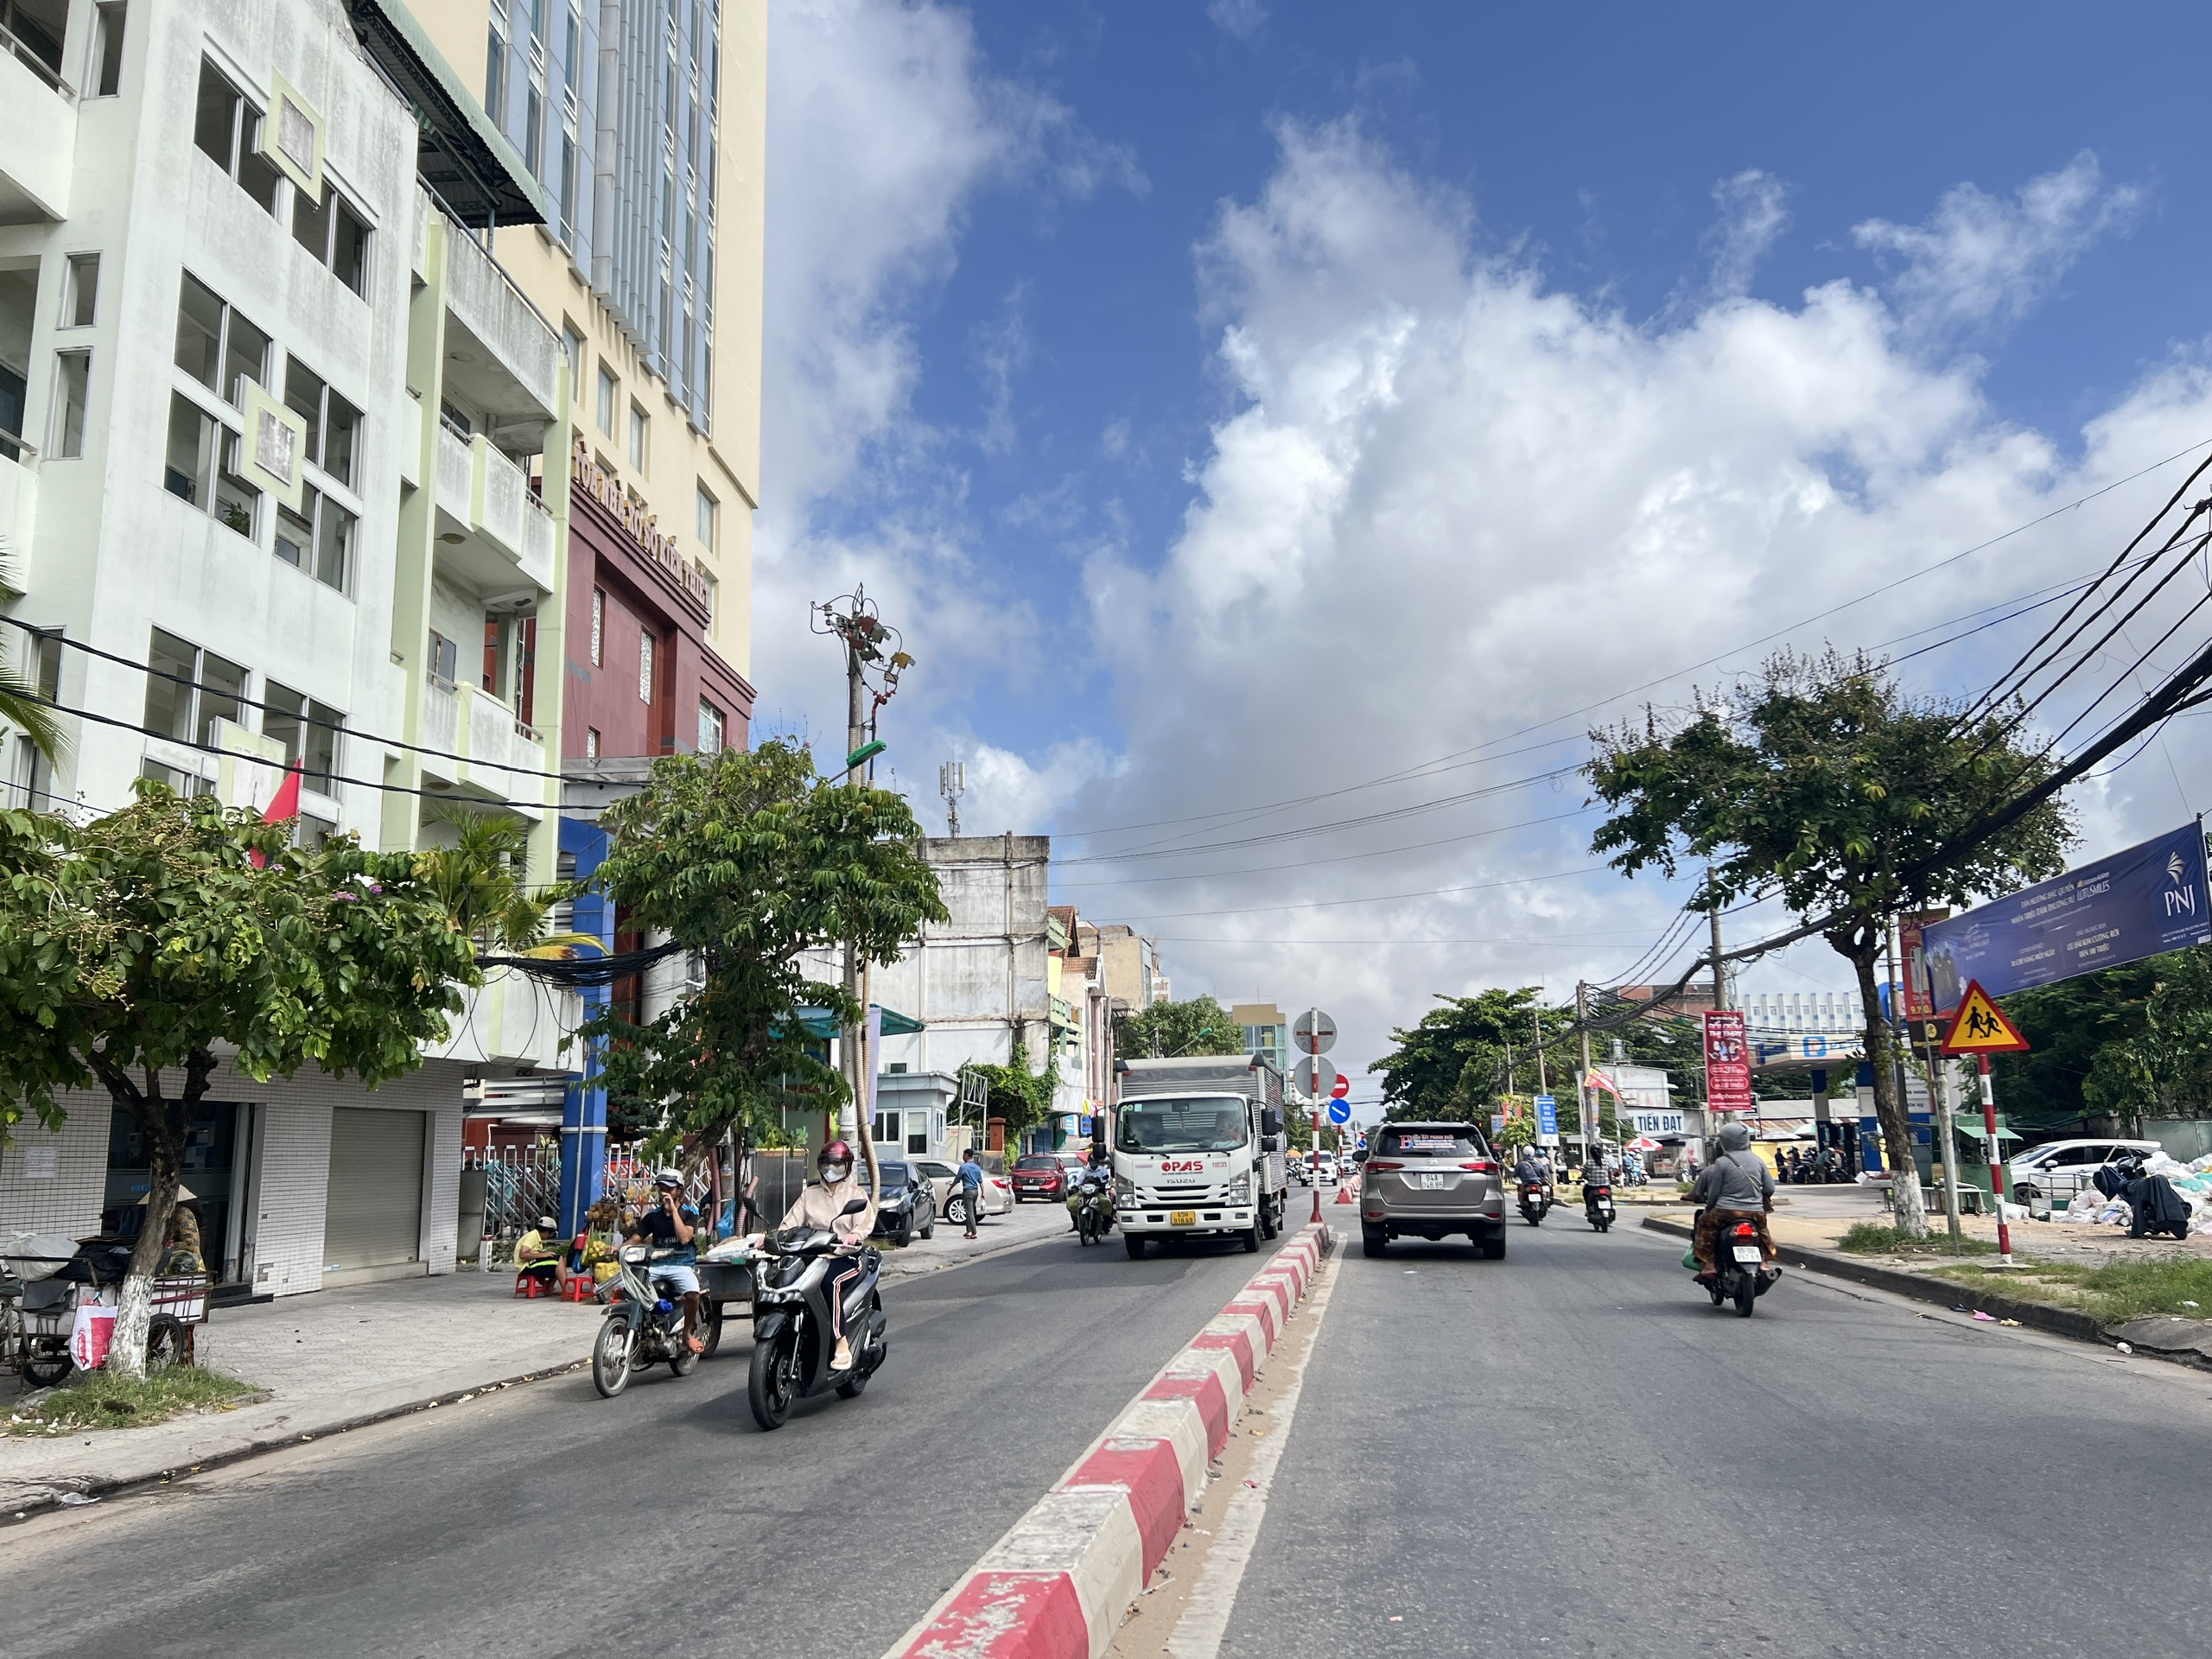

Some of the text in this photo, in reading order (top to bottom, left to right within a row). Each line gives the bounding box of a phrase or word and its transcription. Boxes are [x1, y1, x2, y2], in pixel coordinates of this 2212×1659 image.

[572, 442, 709, 611] TÒA NHÀ XỔ SỐ KIẾN THIẾT
[2164, 884, 2196, 916] PNJ
[1161, 1160, 1204, 1172] OPAS
